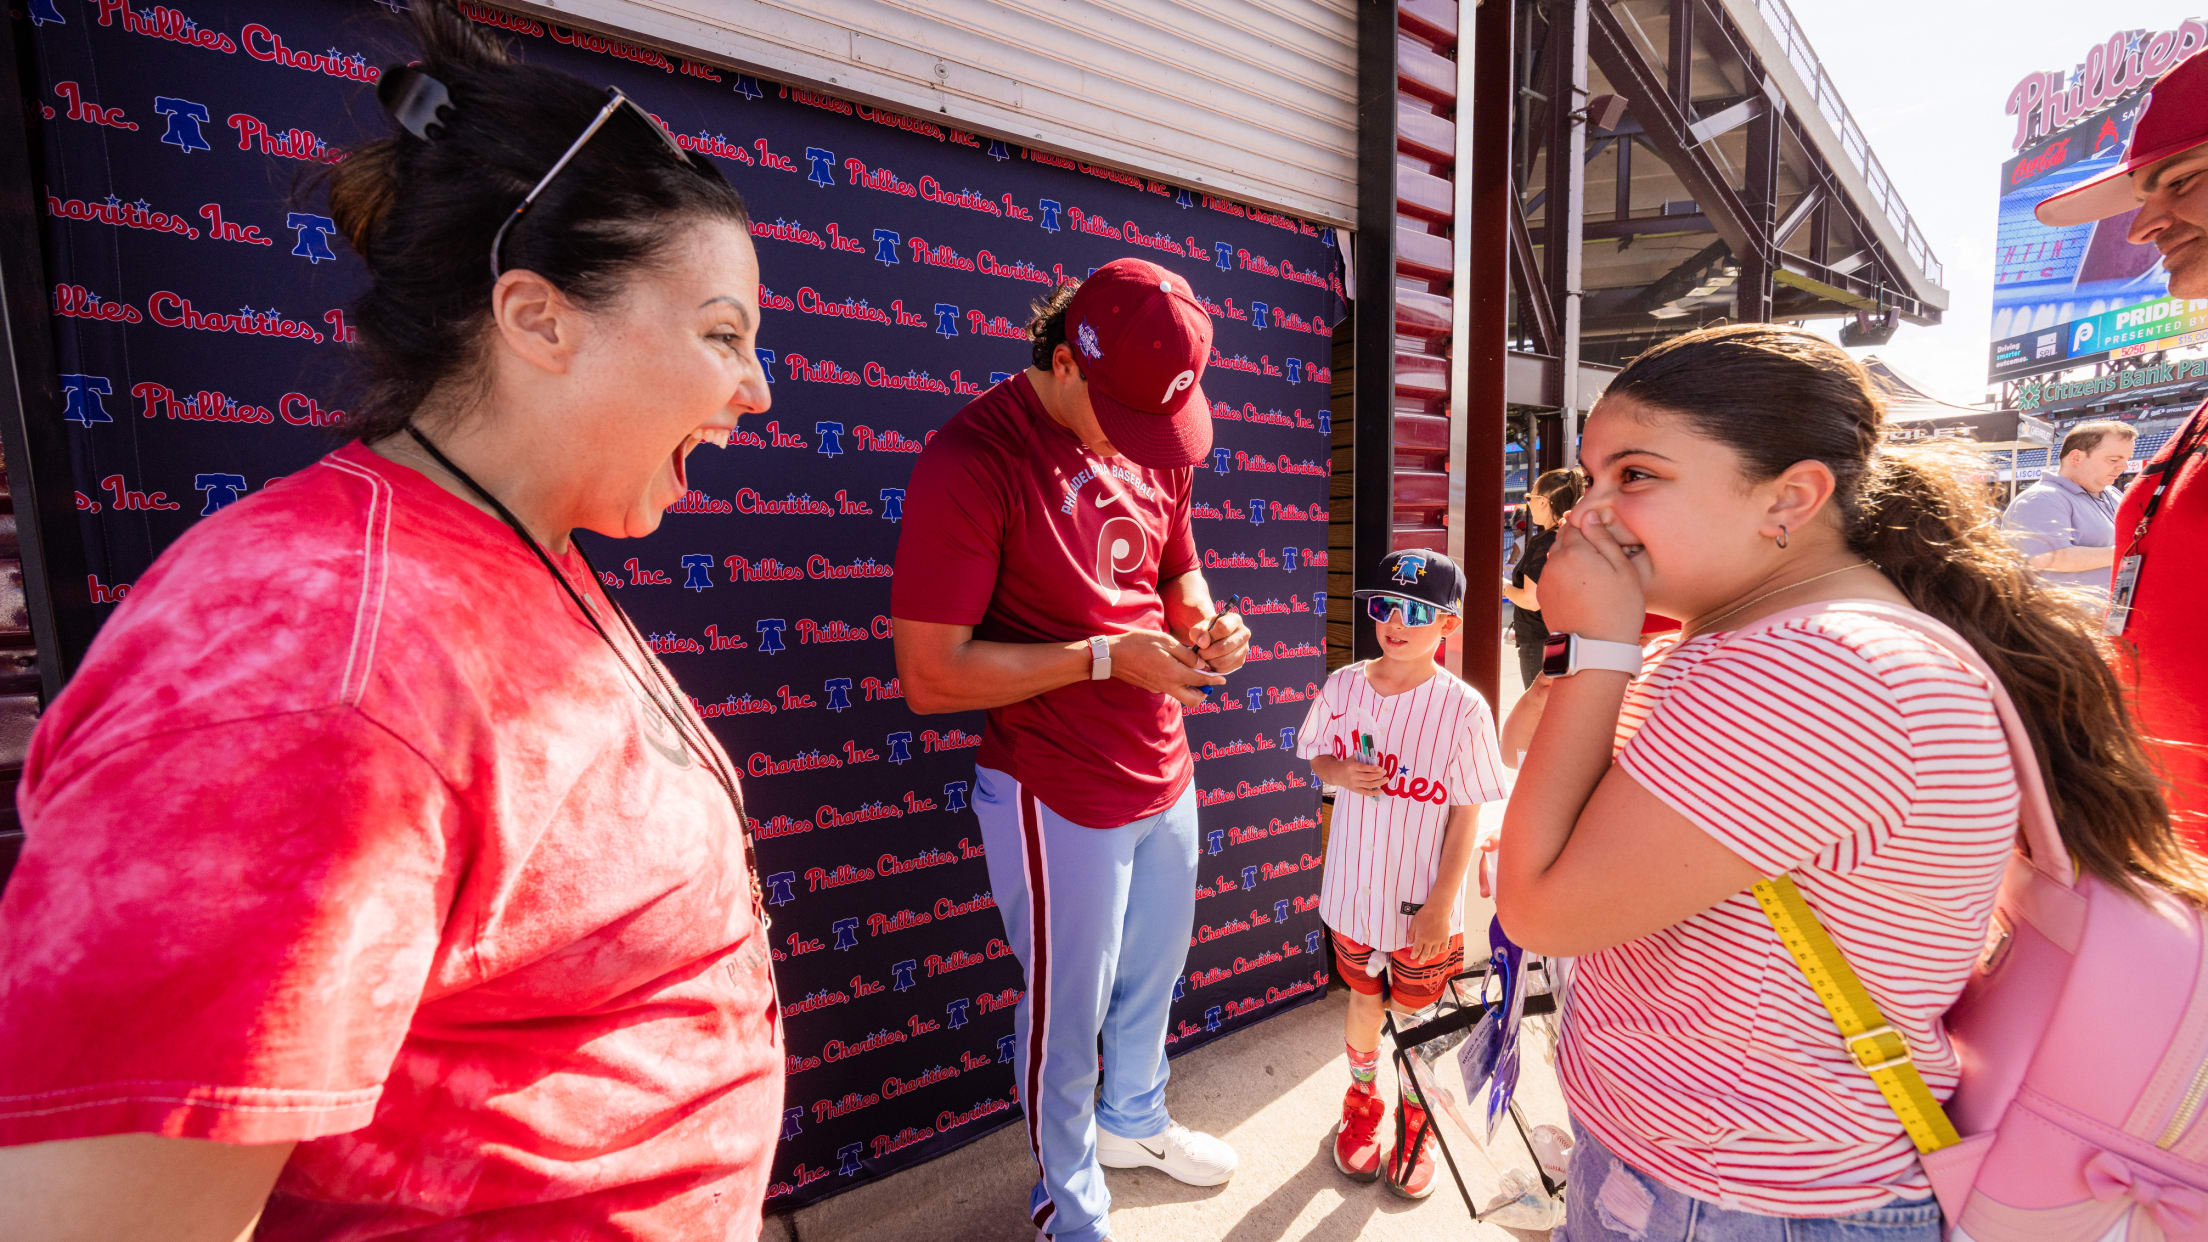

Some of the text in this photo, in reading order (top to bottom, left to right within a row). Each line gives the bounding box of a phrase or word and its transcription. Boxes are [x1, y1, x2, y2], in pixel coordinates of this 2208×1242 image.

[242, 23, 381, 85] Charitie
[55, 81, 353, 164] Inc. Phillie
[45, 185, 272, 246] harities, Inc.
[755, 138, 797, 173] Inc.
[845, 157, 917, 198] Phillies
[919, 175, 1002, 217] Charities,
[1002, 193, 1033, 221] Inc.
[1067, 206, 1122, 241] Phillies
[1123, 221, 1186, 258] Charities,
[1186, 237, 1210, 262] Inc.
[1238, 248, 1279, 277] Phillies
[1280, 260, 1328, 291] Charities,
[1299, 219, 1319, 238] Inc.
[826, 223, 866, 254] Inc.
[908, 237, 974, 272] Phillies
[977, 250, 1054, 287] Charities,
[1054, 263, 1078, 288] Inc
[53, 283, 362, 345] llies Charities, In
[759, 284, 1028, 341] lies Charities, Inc. Phillies
[1225, 298, 1247, 320] Inc.
[1273, 307, 1311, 334] Phillies
[2105, 315, 2207, 345] PRESENTED BY
[2115, 299, 2185, 331] PRIDE
[785, 353, 983, 396] Phillies Charities, Inc.
[1161, 370, 1195, 404] P
[1261, 355, 1282, 377] Inc.
[1306, 362, 1331, 384] Phill
[2043, 359, 2208, 402] Citizens Bank Pa
[131, 382, 274, 424] Phillies
[1206, 397, 1314, 429] hillies Charities, Inc.
[766, 420, 807, 449] Inc.
[852, 424, 923, 453] Phillies
[1235, 451, 1277, 473] Phillies
[1277, 454, 1326, 478] Charities,
[101, 475, 180, 511] Inc.
[666, 487, 872, 517] hillies Charities, Inc.
[1112, 465, 1156, 503] BASEBALL
[1190, 501, 1222, 520] rities,
[1223, 500, 1246, 520] Inc.
[1270, 501, 1308, 521] Phillies
[624, 558, 672, 585] Inc.
[724, 555, 804, 583] Phillies
[807, 553, 894, 579] Charities
[1205, 548, 1328, 569] Charities, Inc. Philli
[1240, 597, 1290, 615] Charities,
[1290, 594, 1309, 613] Inc.
[645, 631, 705, 654] ities,
[704, 624, 747, 650] Inc.
[795, 618, 868, 645] Phillies
[1274, 641, 1321, 659] Charities,
[688, 676, 904, 719] harities, Inc. Phill
[1182, 700, 1220, 717] arities,
[1221, 692, 1242, 710] Inc.
[1267, 685, 1305, 705] Phillies
[748, 748, 843, 778] Charities,
[843, 740, 879, 764] Inc.
[920, 729, 982, 754] Phillies
[1202, 739, 1255, 760] Charities,
[1255, 732, 1276, 750] Inc.
[1196, 771, 1306, 808] Phillies Charities, Inc.
[815, 800, 903, 829] Charities,
[903, 790, 937, 814] Inc.
[1228, 825, 1268, 846] Phillies
[1269, 815, 1316, 836] Charities,
[804, 837, 985, 892] Phillies Charities, Inc
[1216, 875, 1237, 894] Inc.
[1261, 861, 1298, 881] Phillies
[787, 932, 825, 957] Inc.
[867, 909, 932, 936] Phillies
[1198, 918, 1250, 943] Charities,
[1250, 909, 1270, 927] Inc.
[850, 975, 885, 998] Inc.
[924, 950, 984, 977] Phillies
[1190, 941, 1302, 990] Phillies Charities, Inc.
[1178, 1020, 1201, 1039] Inc.
[1225, 997, 1265, 1019] Phillies
[1266, 980, 1314, 1003] Charities,
[1313, 971, 1329, 988] Inc
[785, 988, 1025, 1076] llies Charities, Inc. Phillie
[812, 1050, 990, 1123] Phillies Charities, Inc.
[794, 1098, 1009, 1188] Inc. Phillies Charities,
